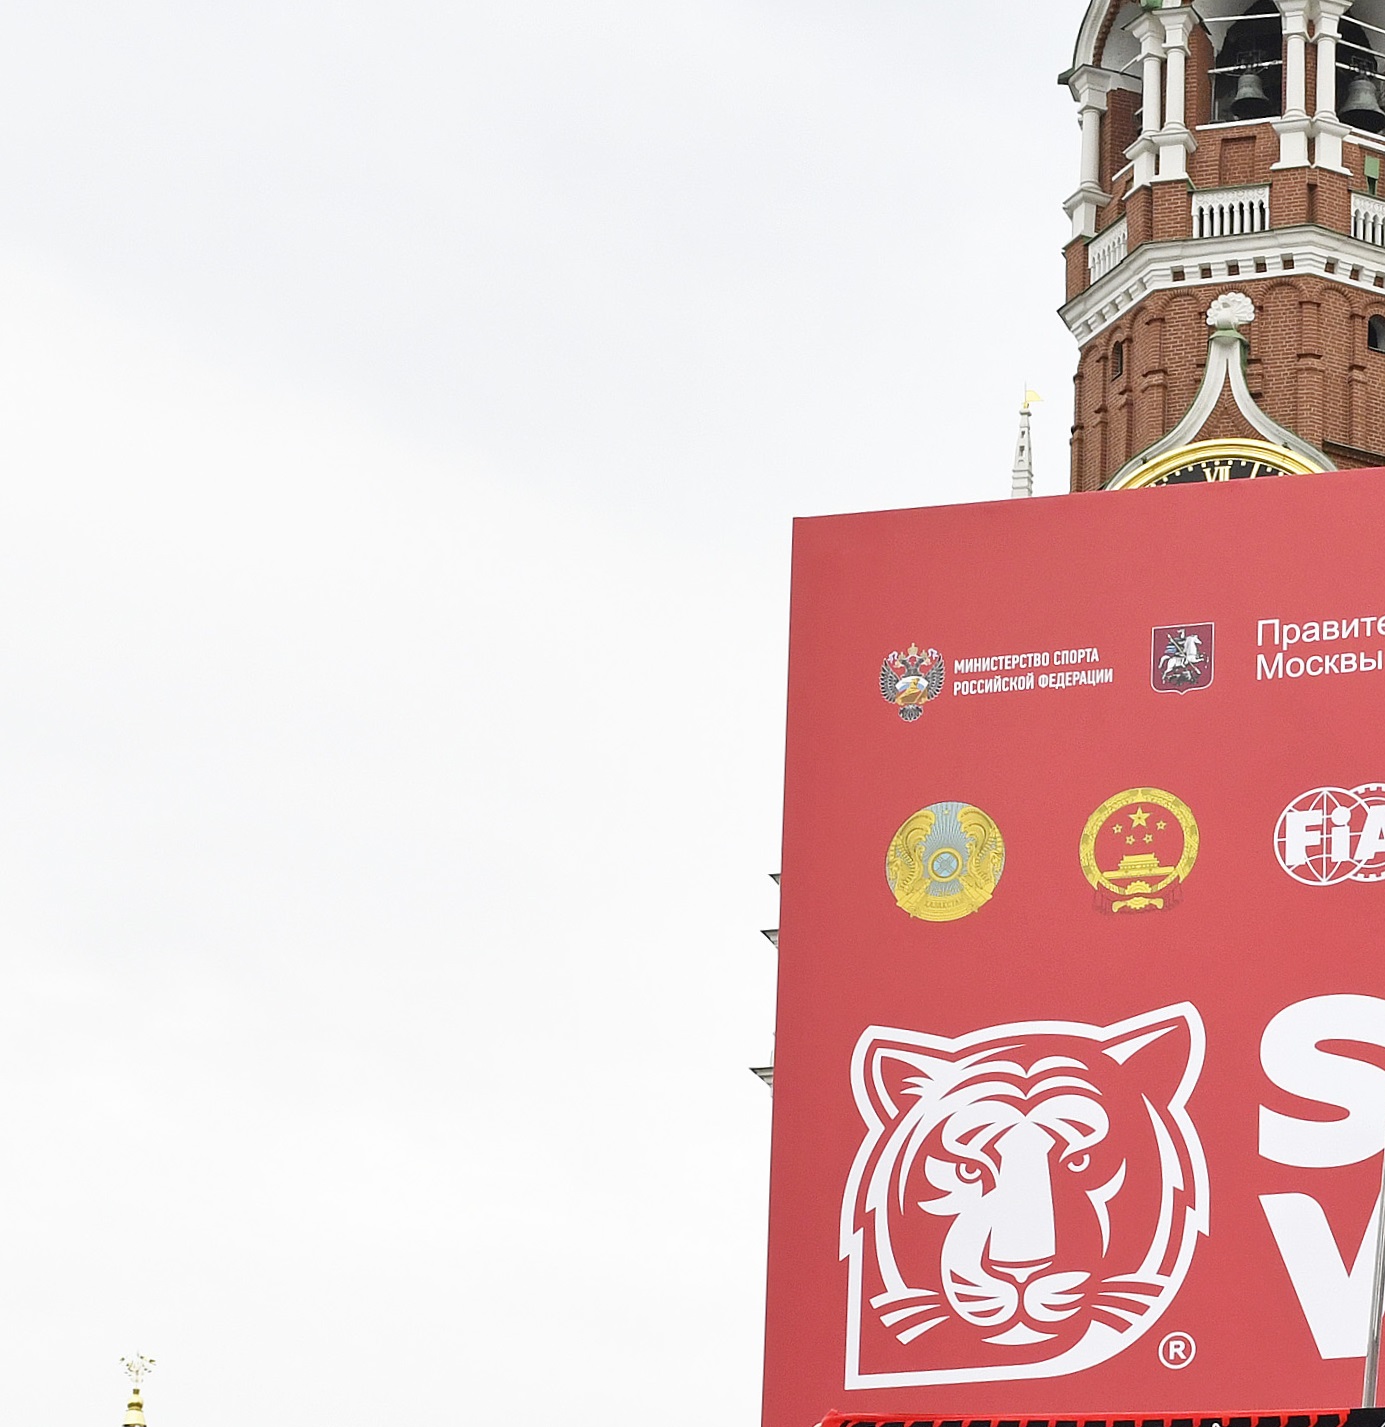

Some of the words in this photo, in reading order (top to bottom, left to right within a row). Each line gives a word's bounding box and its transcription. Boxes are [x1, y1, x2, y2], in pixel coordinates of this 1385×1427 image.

[953, 651, 1050, 675] МИНИСТЕРСТВО
[1053, 647, 1100, 666] СПОРТА
[1255, 650, 1384, 681] Москвы
[953, 672, 1035, 697] РОССИЙСКОЙ
[1038, 667, 1113, 690] ФЕДЕРАЦИИ
